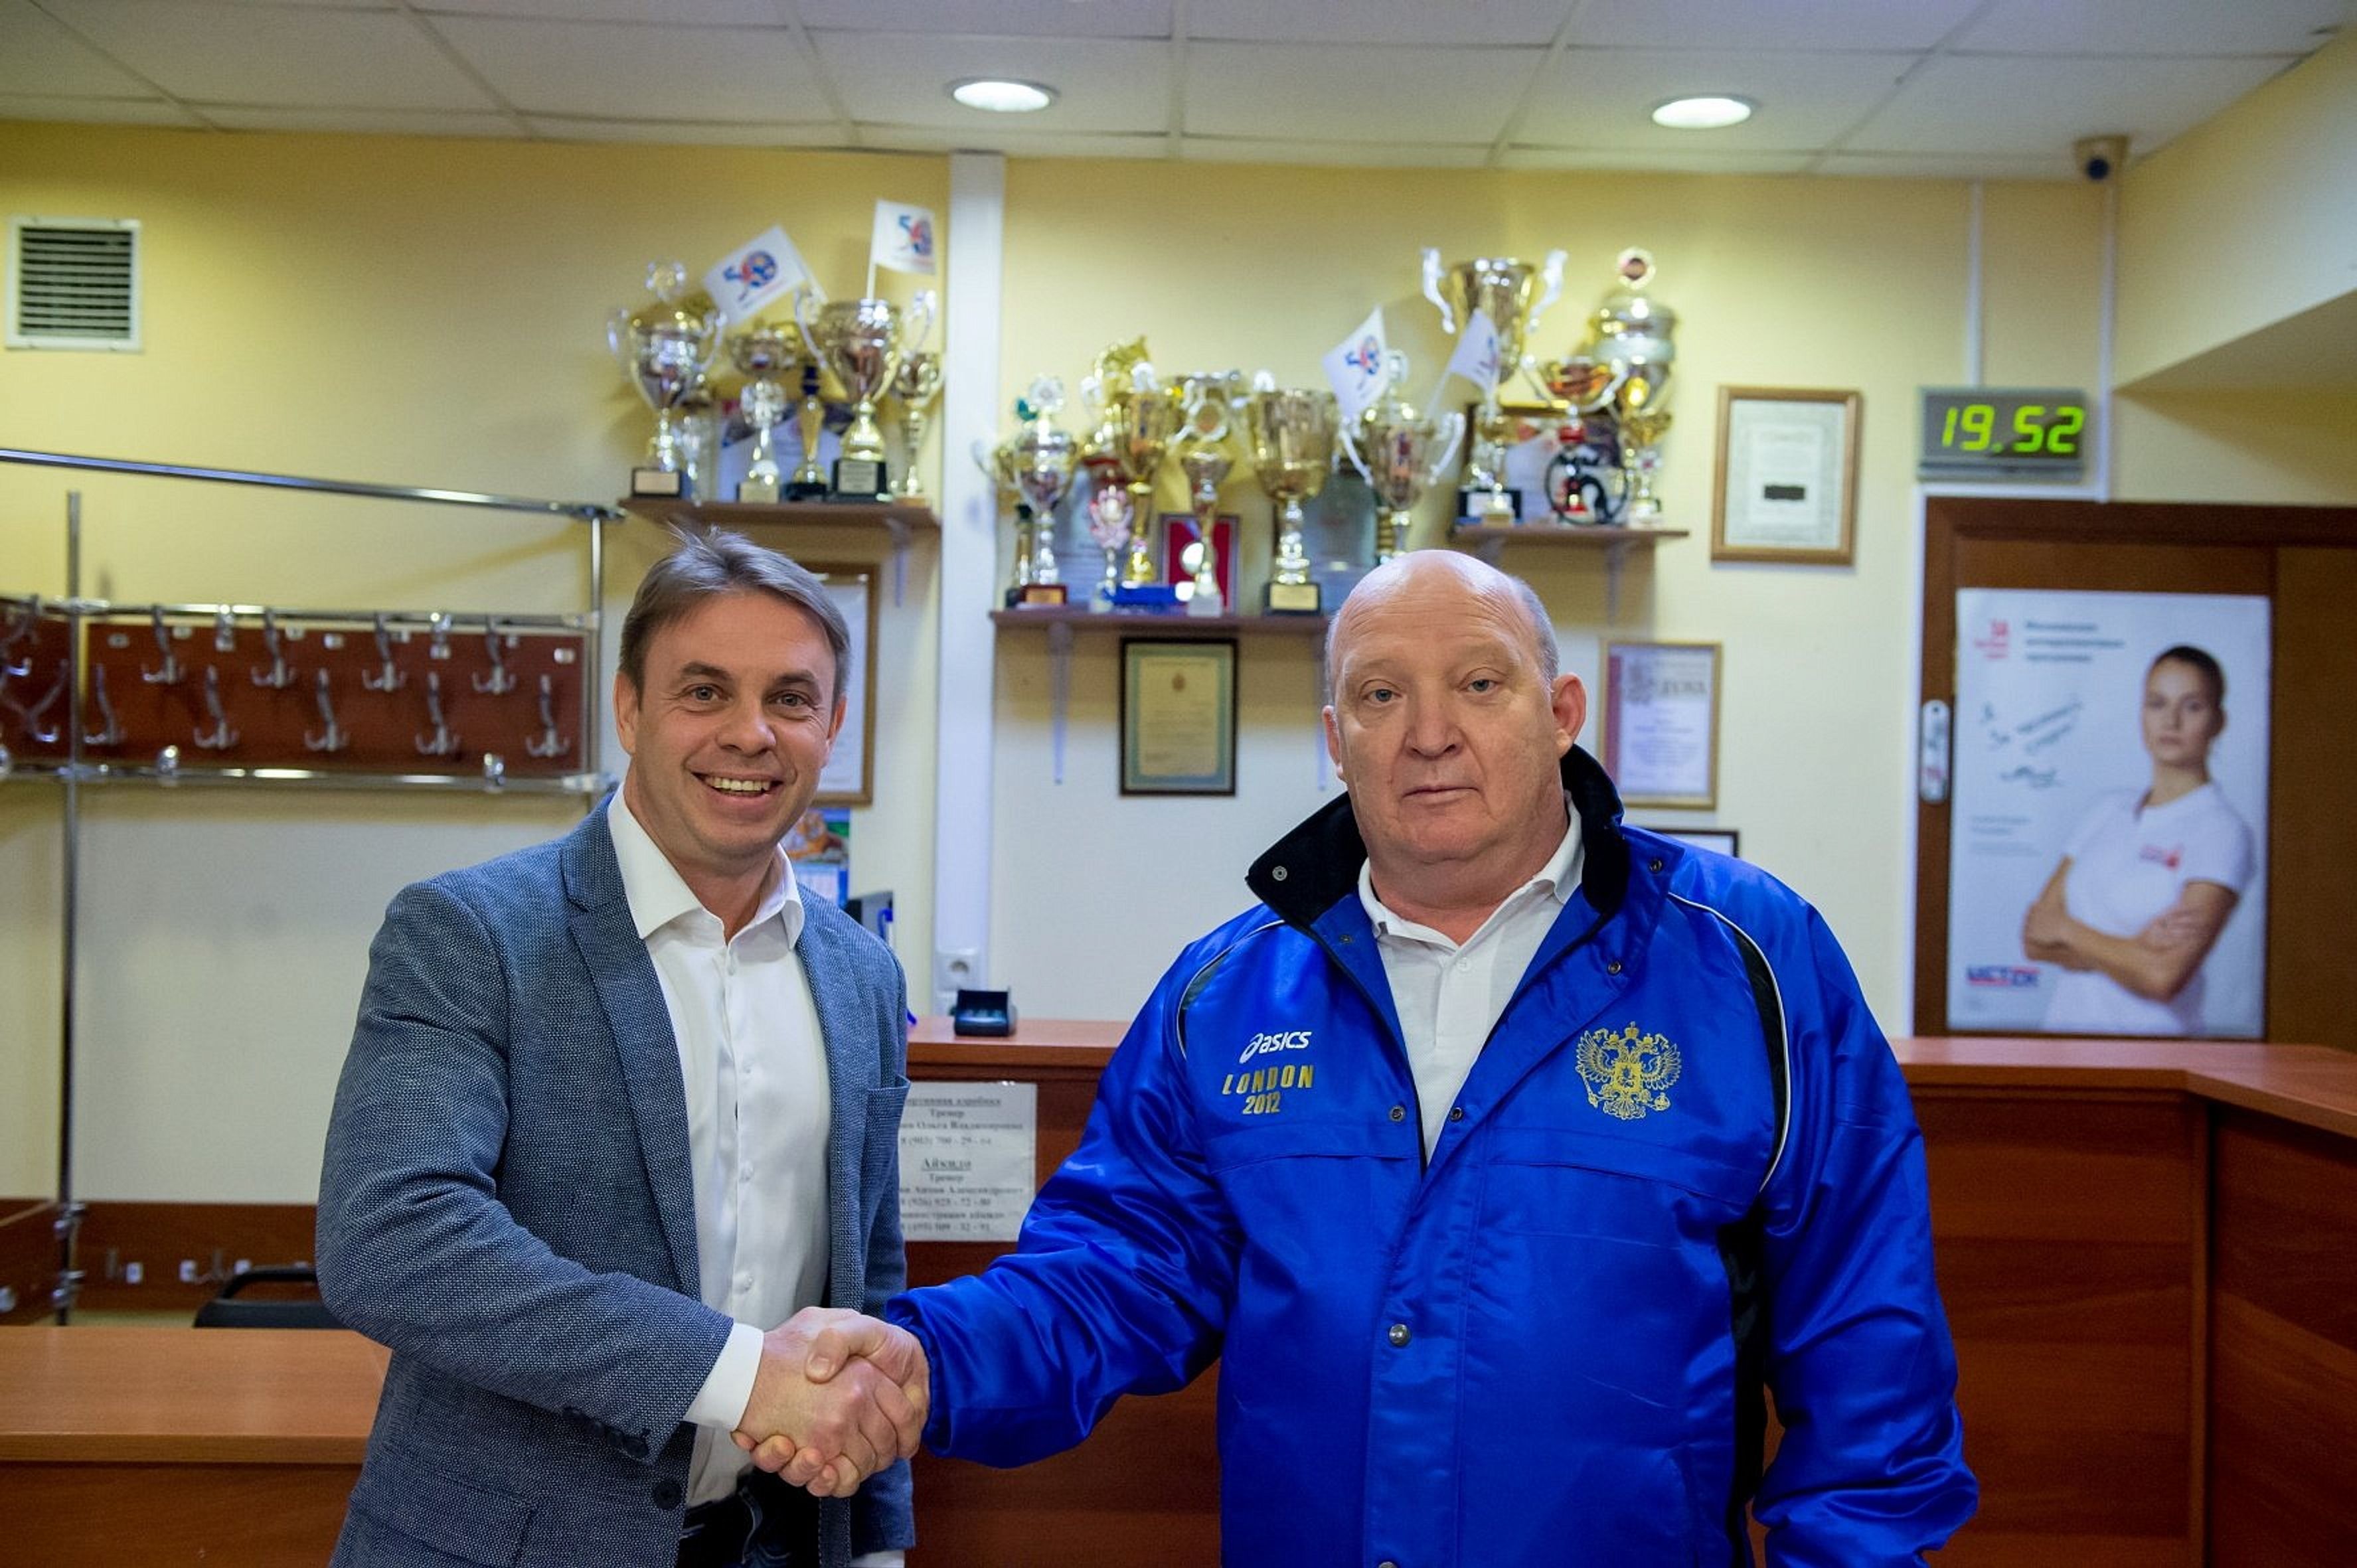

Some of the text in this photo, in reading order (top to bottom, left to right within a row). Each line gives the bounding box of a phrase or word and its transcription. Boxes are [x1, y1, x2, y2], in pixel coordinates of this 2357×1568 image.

[1222, 1065, 1314, 1095] LONDON
[1242, 1091, 1281, 1115] 2012
[922, 1158, 971, 1170] Айкидо
